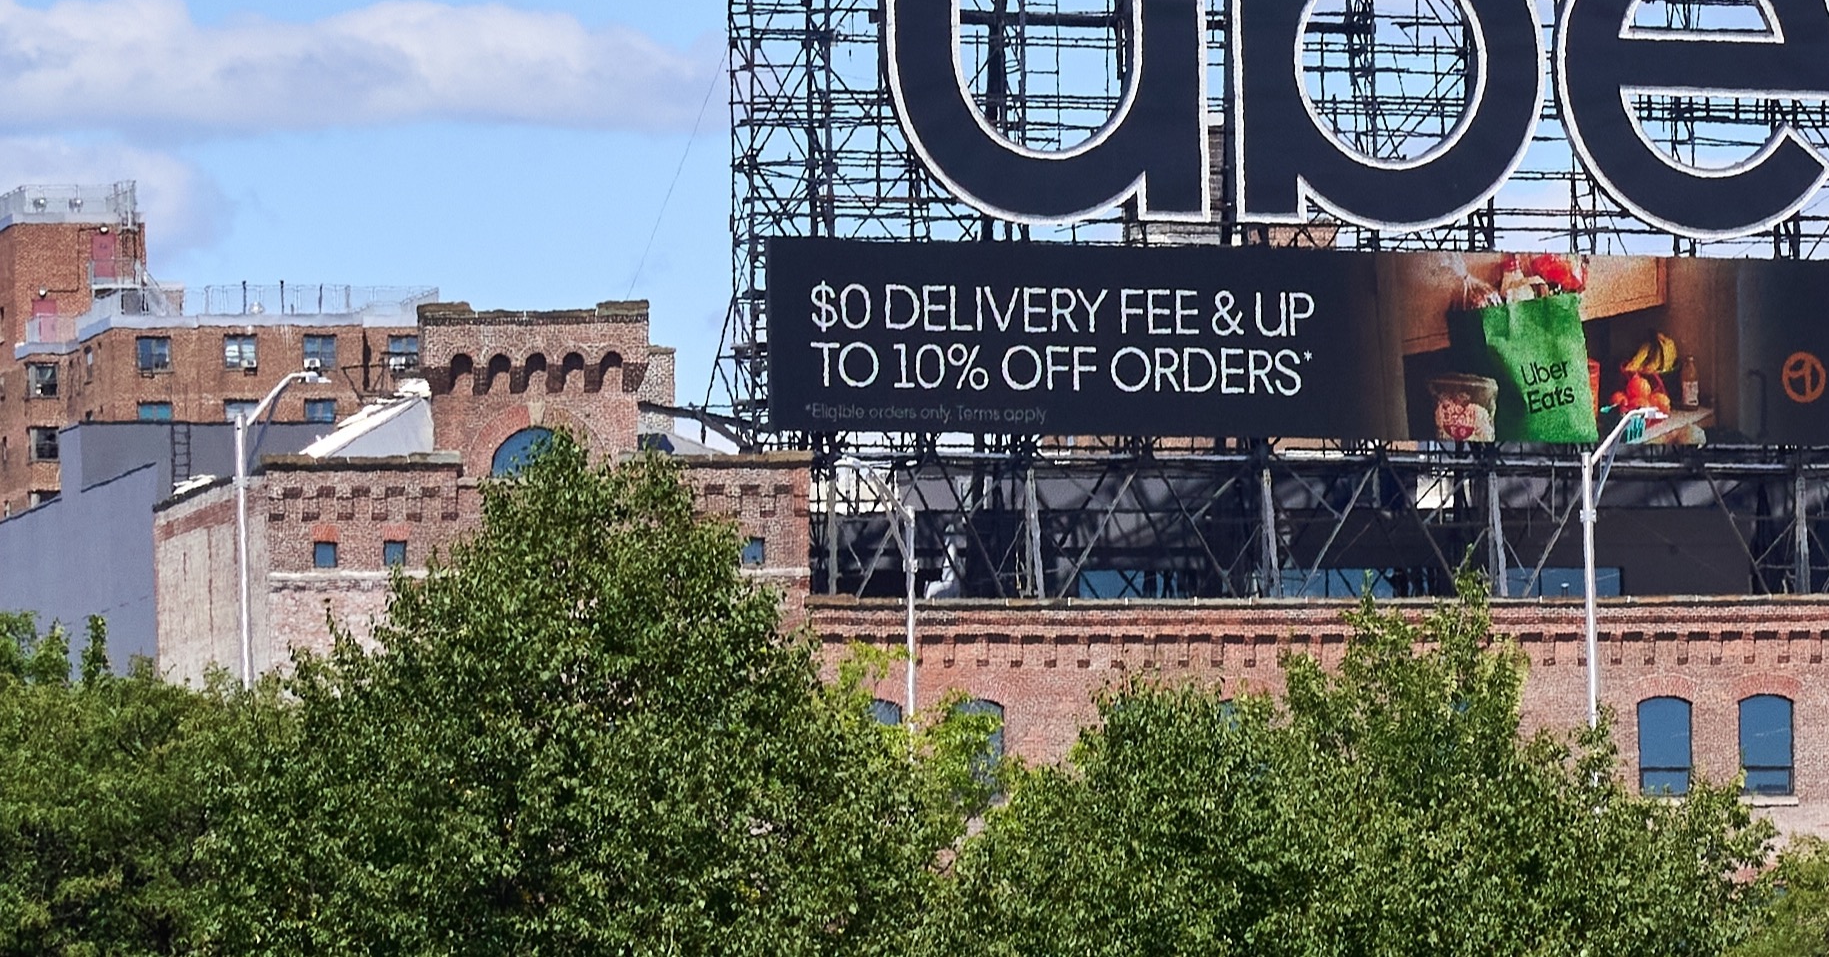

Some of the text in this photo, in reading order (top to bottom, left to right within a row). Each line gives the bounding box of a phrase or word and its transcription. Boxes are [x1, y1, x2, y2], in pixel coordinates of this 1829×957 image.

[810, 279, 1315, 338] $0 DELIVERY FEE & UP
[809, 341, 880, 388] TO
[893, 343, 990, 391] 10%
[1001, 344, 1097, 392] OFF
[1520, 361, 1568, 387] Uber
[1526, 386, 1575, 414] Eats
[869, 403, 917, 421] orders
[956, 404, 1000, 422] Terms
[1003, 405, 1048, 426] apply
